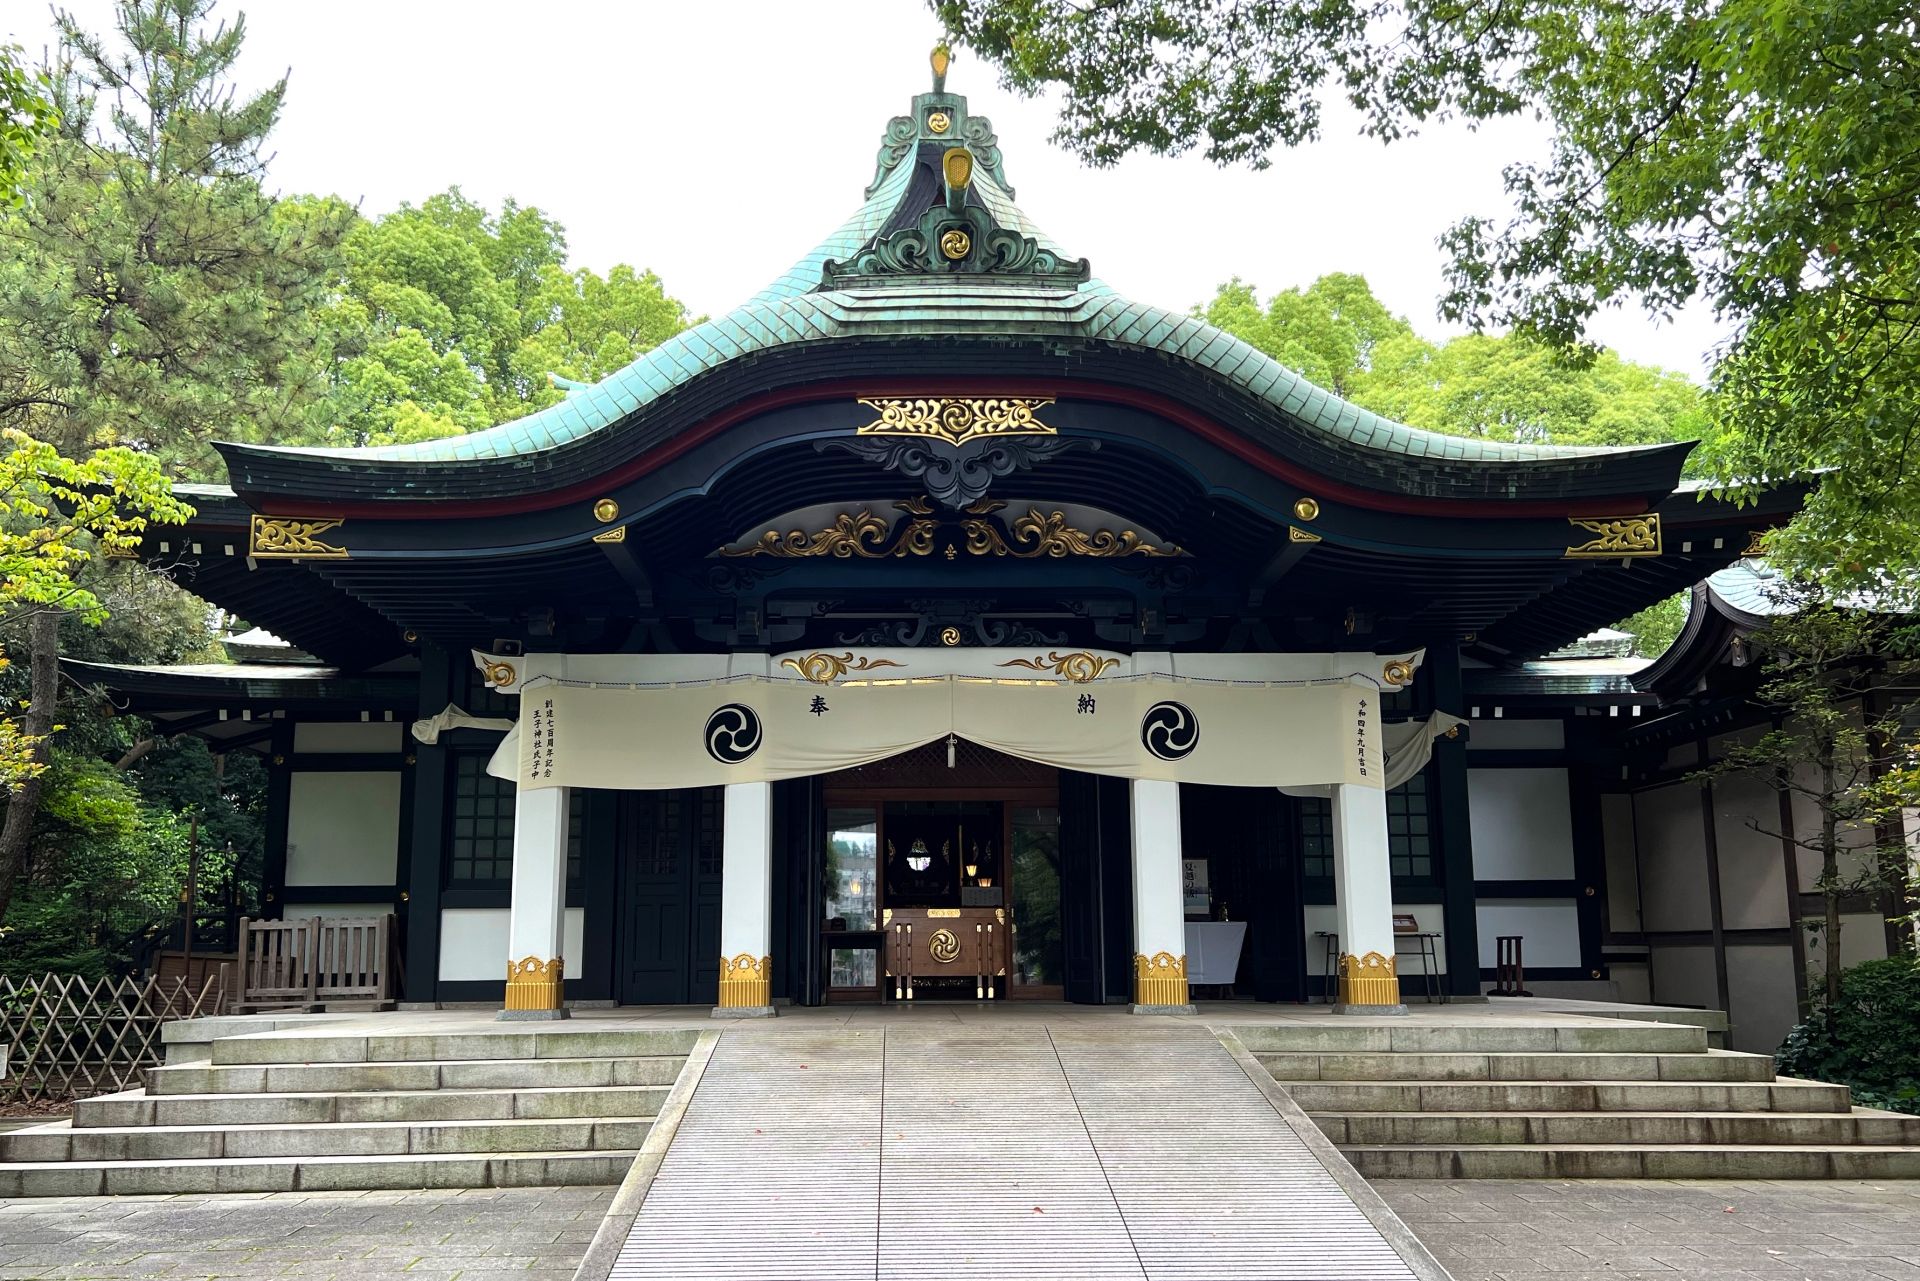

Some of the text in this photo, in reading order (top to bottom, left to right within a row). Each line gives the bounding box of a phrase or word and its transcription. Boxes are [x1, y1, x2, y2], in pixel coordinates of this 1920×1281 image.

[544, 699, 554, 778] 創建七百周年記念
[809, 693, 1096, 717] 奉 納
[1357, 699, 1367, 777] 令和四年九月吉日
[531, 709, 542, 780] 王子神社氏子中
